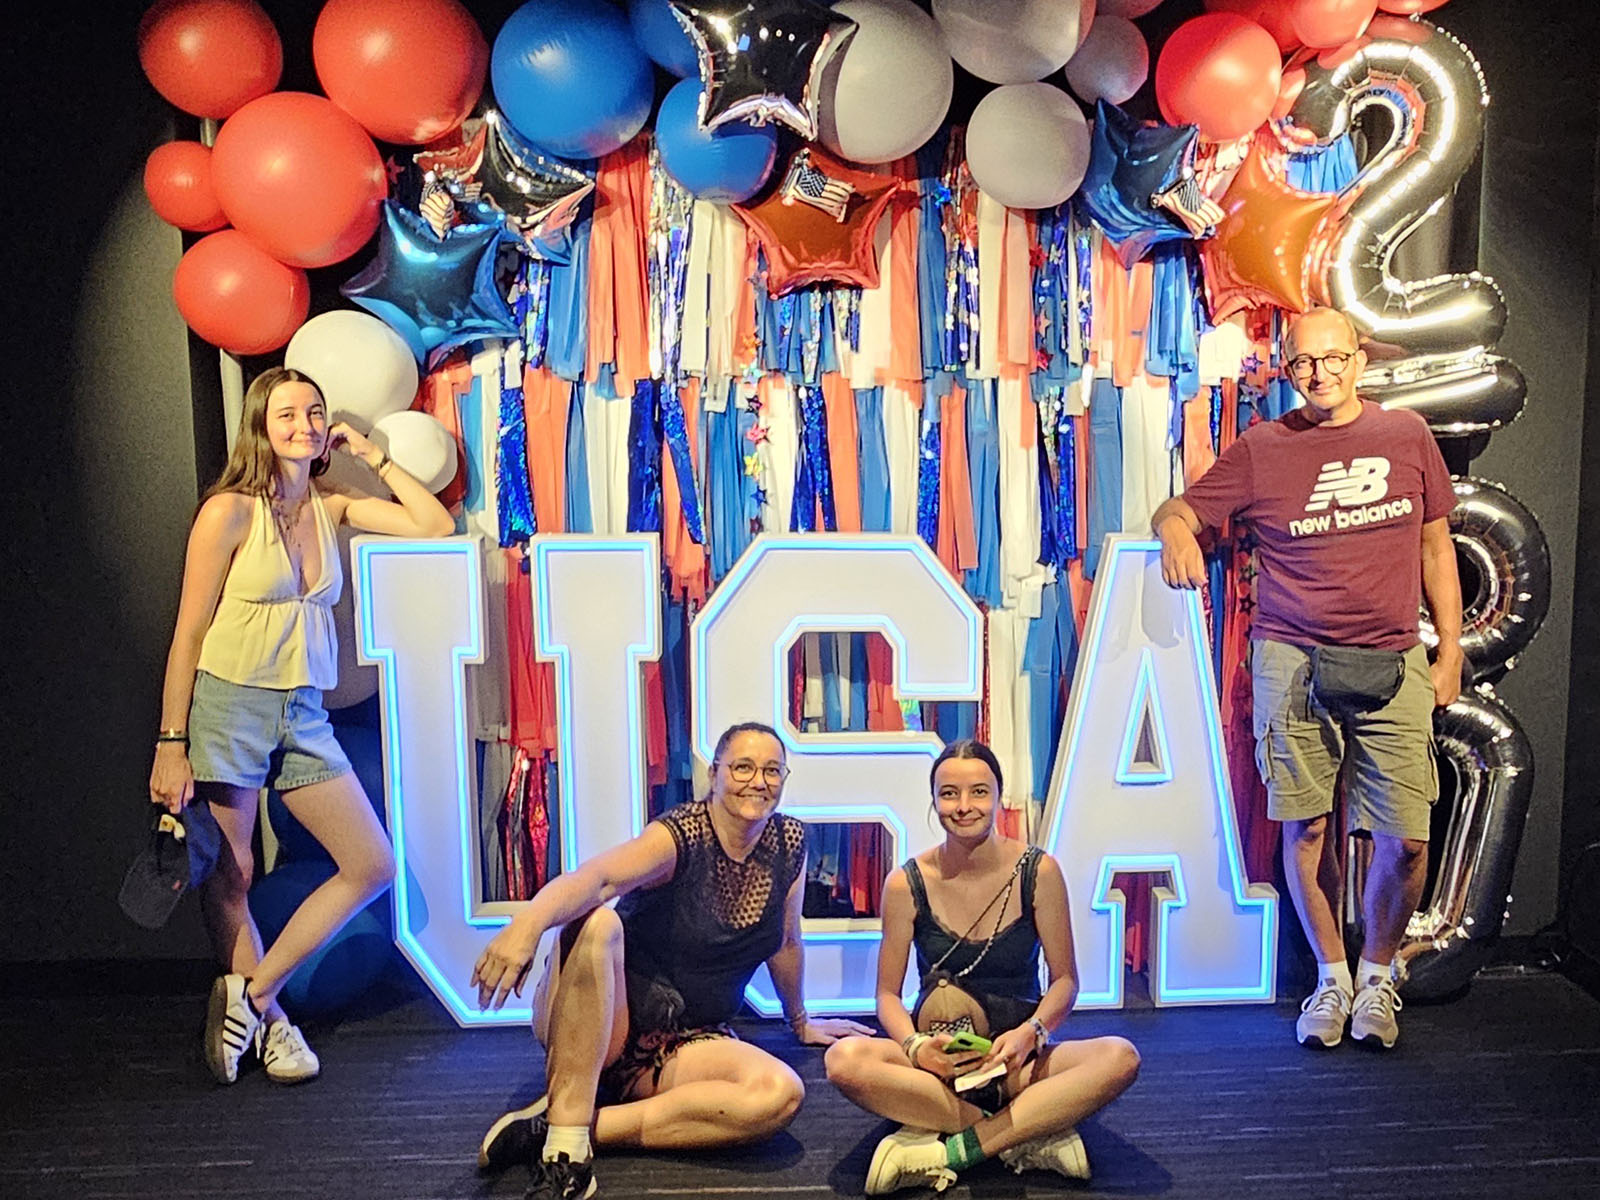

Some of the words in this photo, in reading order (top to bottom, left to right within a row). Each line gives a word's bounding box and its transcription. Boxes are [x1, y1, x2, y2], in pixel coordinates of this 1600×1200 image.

[1304, 456, 1391, 512] NB
[1288, 514, 1331, 538] new
[1333, 497, 1413, 530] balance
[350, 531, 1280, 1029] USA
